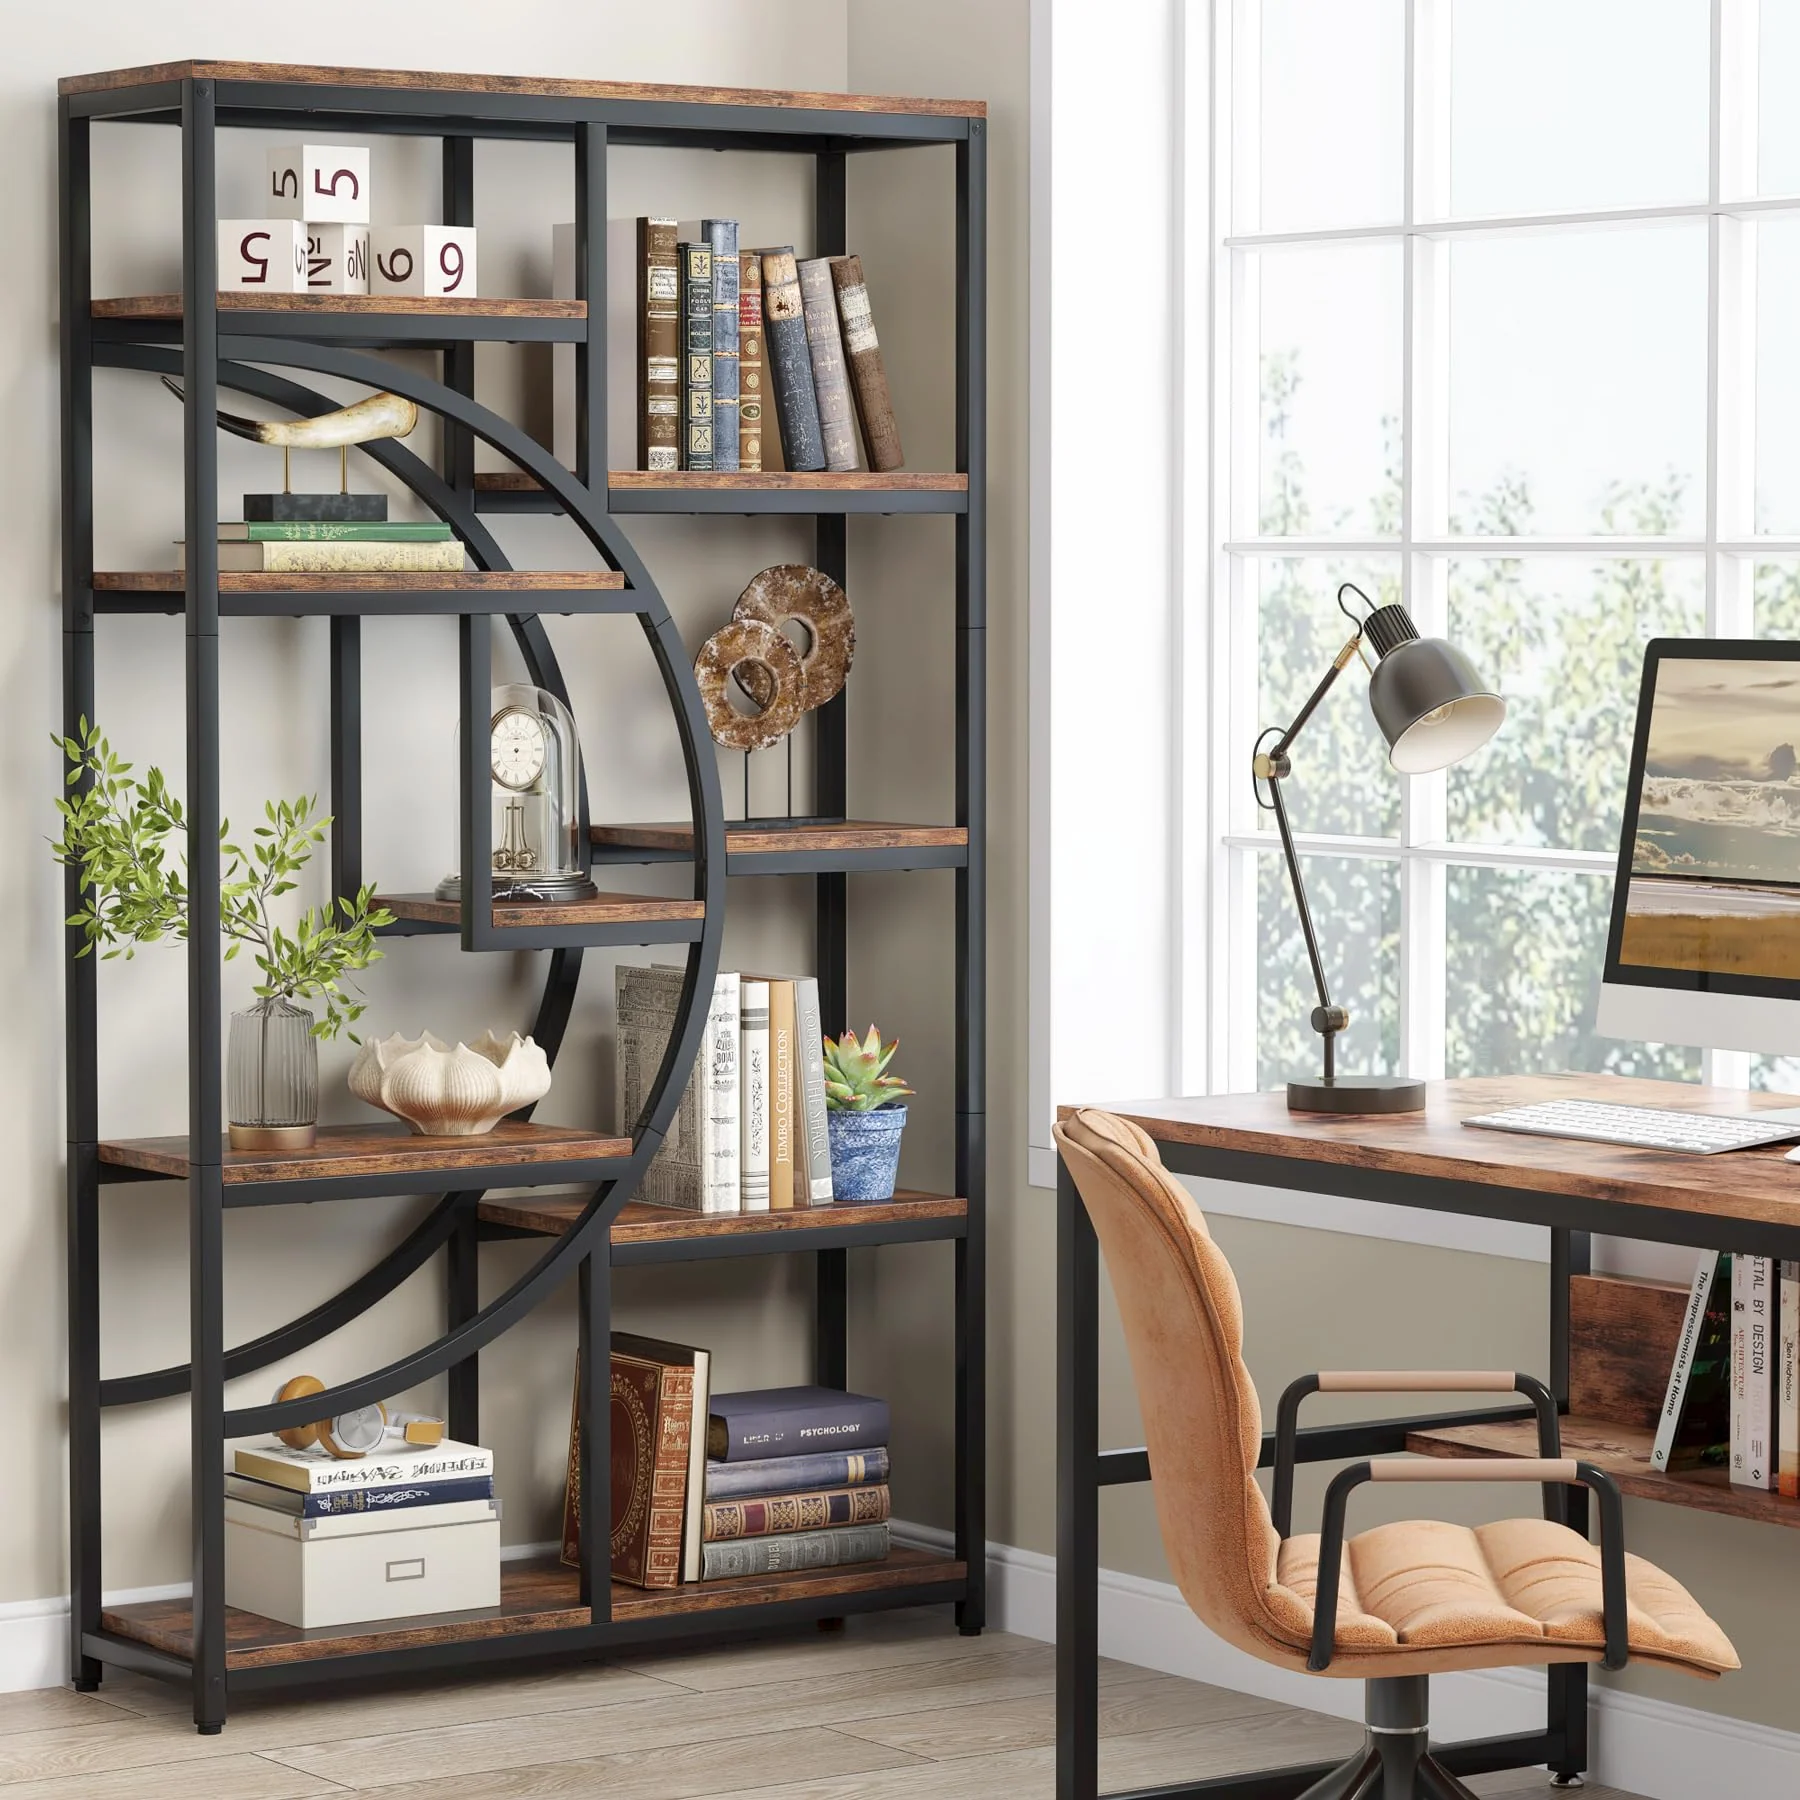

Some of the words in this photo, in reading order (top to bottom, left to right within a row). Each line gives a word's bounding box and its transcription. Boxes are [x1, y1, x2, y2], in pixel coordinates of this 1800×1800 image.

[272, 168, 298, 199] 5
[314, 168, 359, 200] 5
[240, 232, 271, 283] 5
[803, 1006, 818, 1062] YOUNG
[775, 1029, 788, 1114] COLLECTION
[807, 1079, 823, 1106] THE
[776, 1117, 790, 1164] JUMBO
[810, 1110, 827, 1161] SHACK
[1697, 1271, 1708, 1290] The
[1752, 1299, 1764, 1316] BY
[1678, 1293, 1703, 1369] Impressionists
[1752, 1323, 1764, 1375] DESIGN
[1674, 1370, 1682, 1384] at
[1785, 1360, 1793, 1401] Nicholson
[1666, 1386, 1680, 1417] Home
[800, 1423, 861, 1438] PSYCHOLOGY
